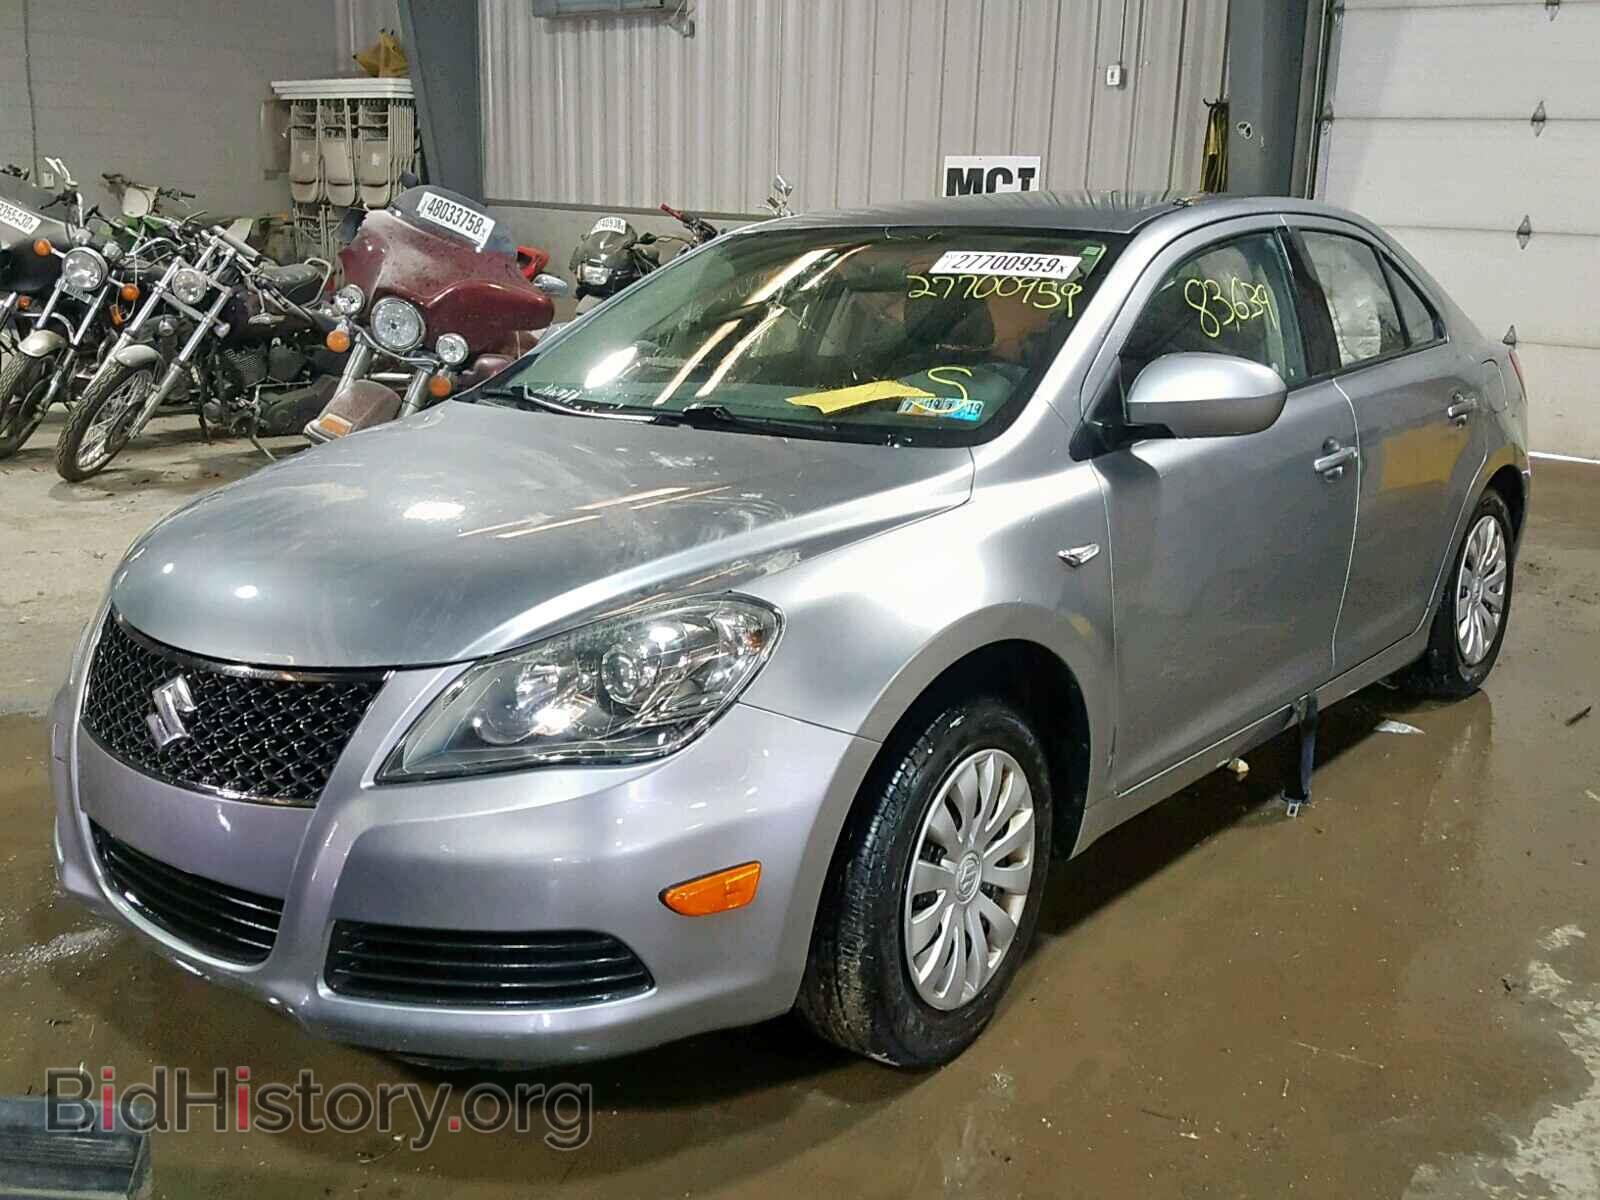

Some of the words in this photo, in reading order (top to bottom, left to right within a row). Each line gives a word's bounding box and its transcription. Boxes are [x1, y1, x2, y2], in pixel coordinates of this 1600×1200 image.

[426, 198, 484, 235] 48033758
[951, 254, 1060, 273] 27700959
[906, 274, 1083, 318] 27700959
